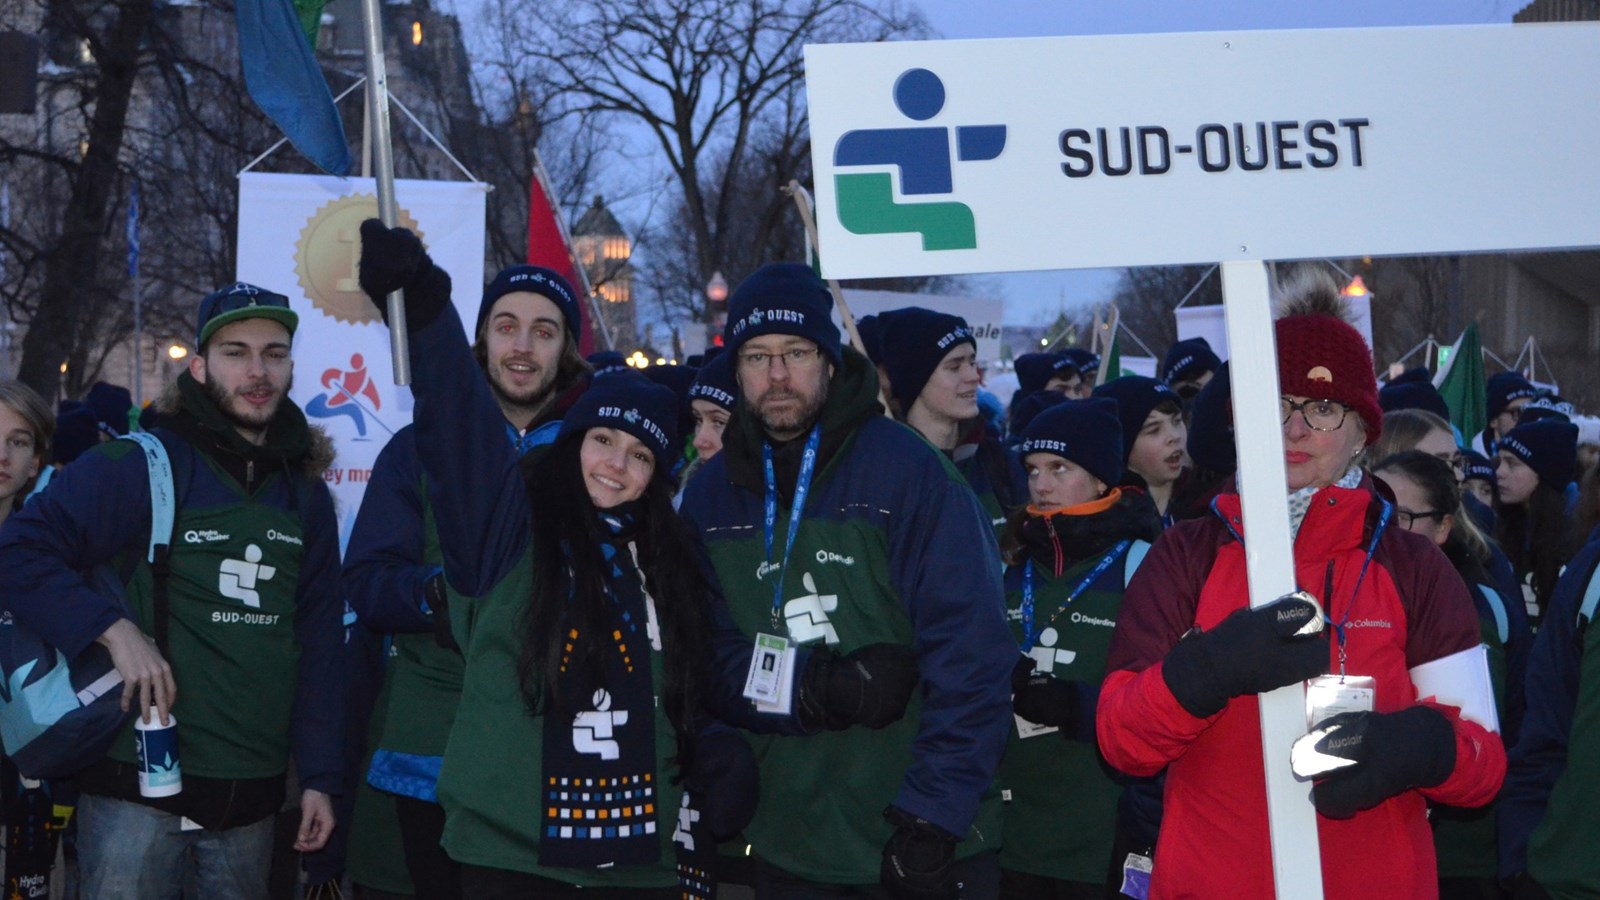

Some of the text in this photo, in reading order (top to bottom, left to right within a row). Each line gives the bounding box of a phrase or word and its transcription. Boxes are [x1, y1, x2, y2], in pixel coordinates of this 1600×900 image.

[1058, 117, 1370, 178] SUD-OUEST
[767, 309, 805, 326] OUEST
[700, 385, 734, 406] OUEST
[598, 406, 669, 450] SUD OUEST
[1033, 440, 1067, 452] OUEST
[212, 611, 280, 625] SUD-OUEST
[1277, 606, 1311, 621] Auclair
[1082, 615, 1116, 628] Desjardins
[1354, 619, 1392, 629] Columbia
[1328, 735, 1363, 750] Auclair
[19, 873, 46, 888] Hydro
